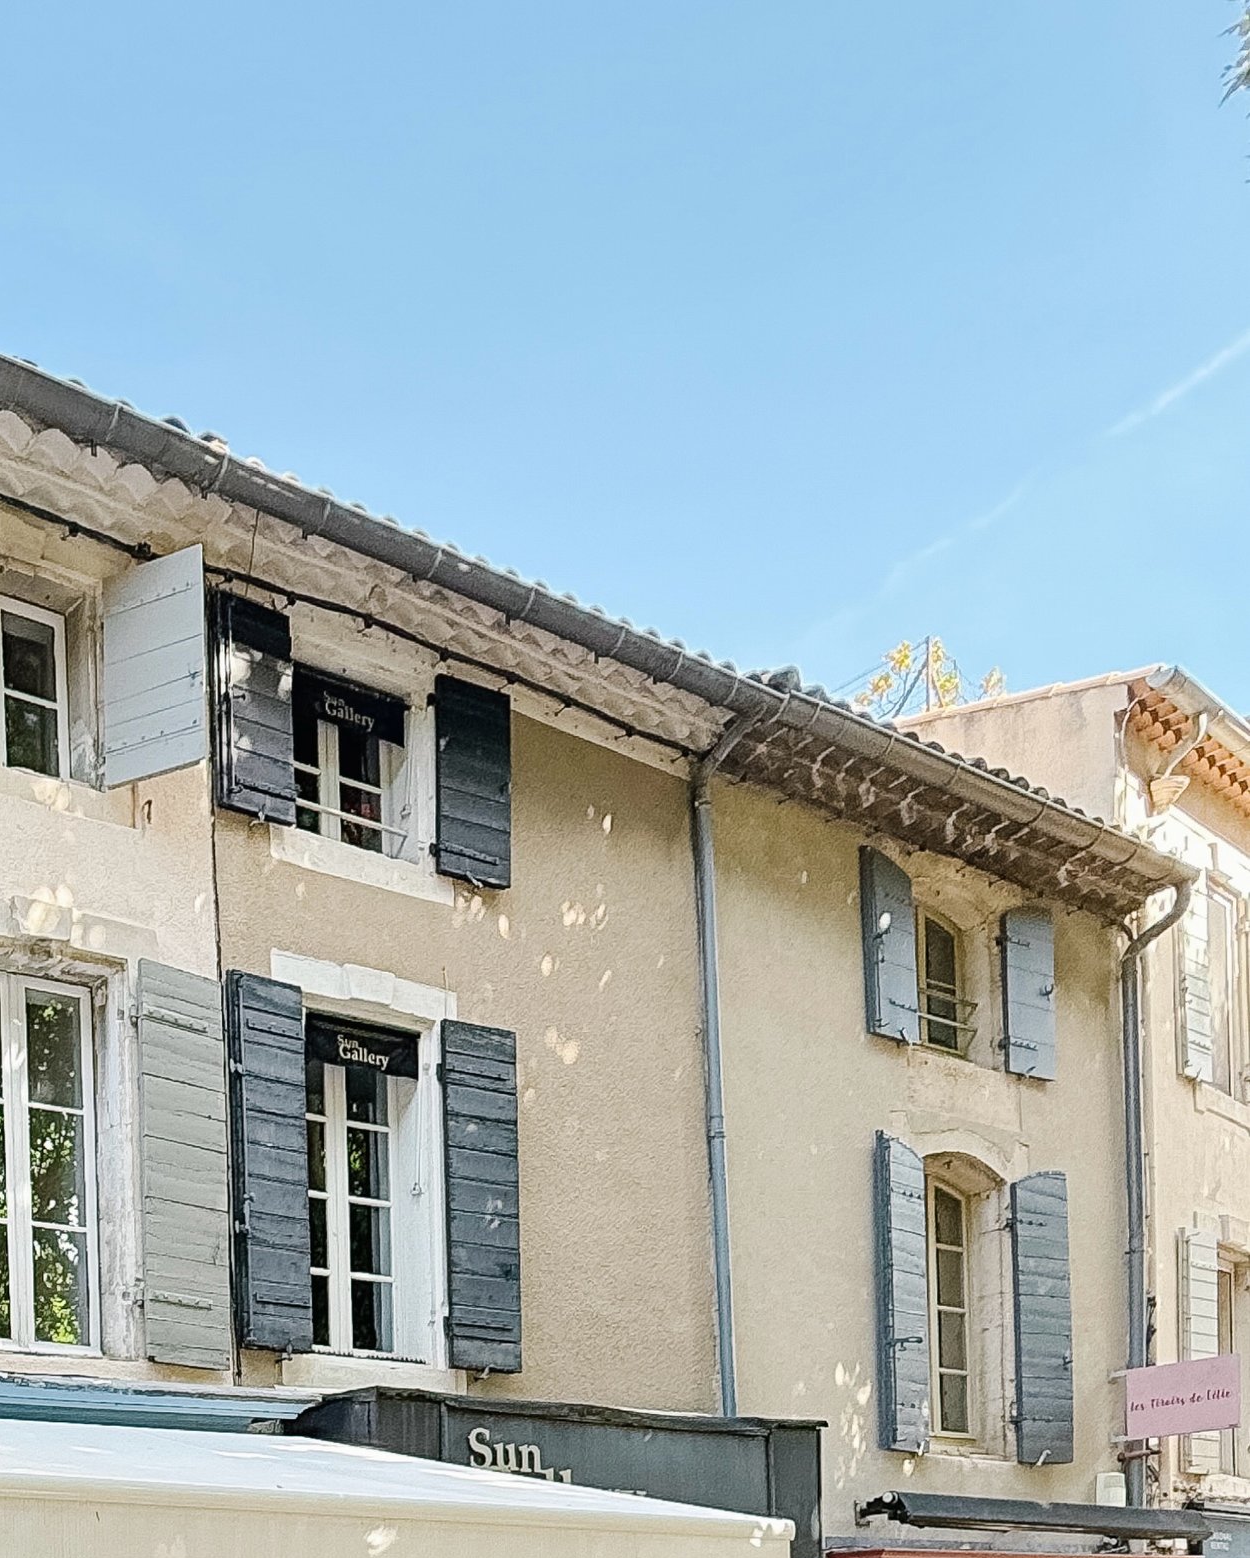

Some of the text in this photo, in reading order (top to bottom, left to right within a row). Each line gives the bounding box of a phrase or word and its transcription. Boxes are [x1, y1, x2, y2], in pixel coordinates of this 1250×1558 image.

[325, 699, 375, 732] Gallery
[337, 1034, 359, 1049] Sun
[339, 1043, 390, 1071] Gallery
[1189, 1393, 1202, 1404] de
[468, 1427, 542, 1473] Sun
